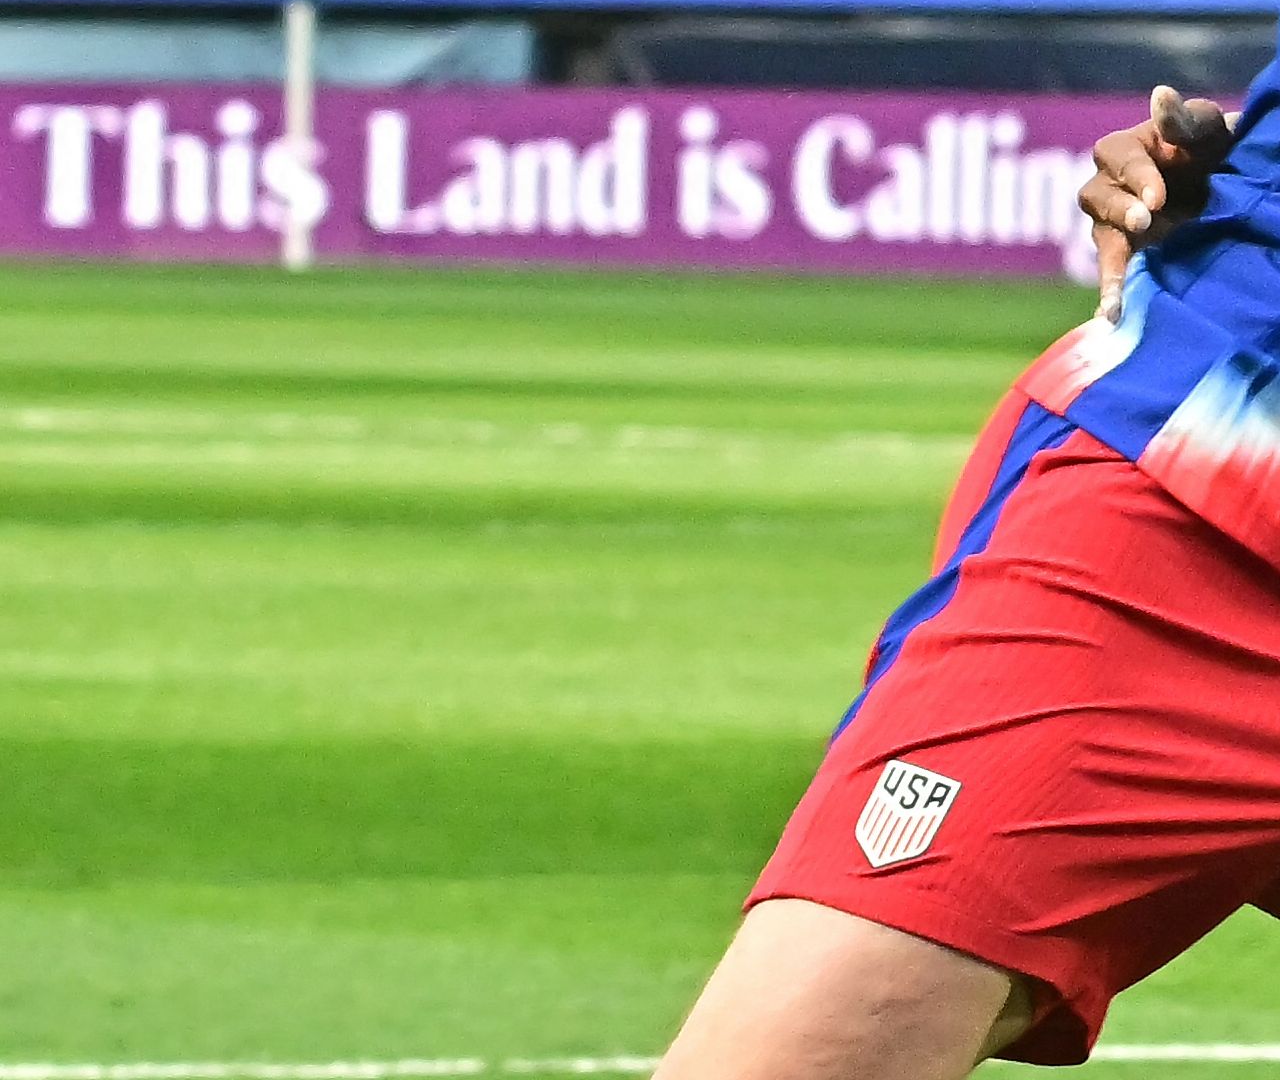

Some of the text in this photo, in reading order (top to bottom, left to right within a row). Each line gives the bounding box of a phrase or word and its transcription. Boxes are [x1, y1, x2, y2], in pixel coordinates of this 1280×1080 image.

[15, 100, 329, 232] This
[366, 104, 650, 236] Land
[676, 106, 772, 240] is
[883, 767, 952, 810] USA
